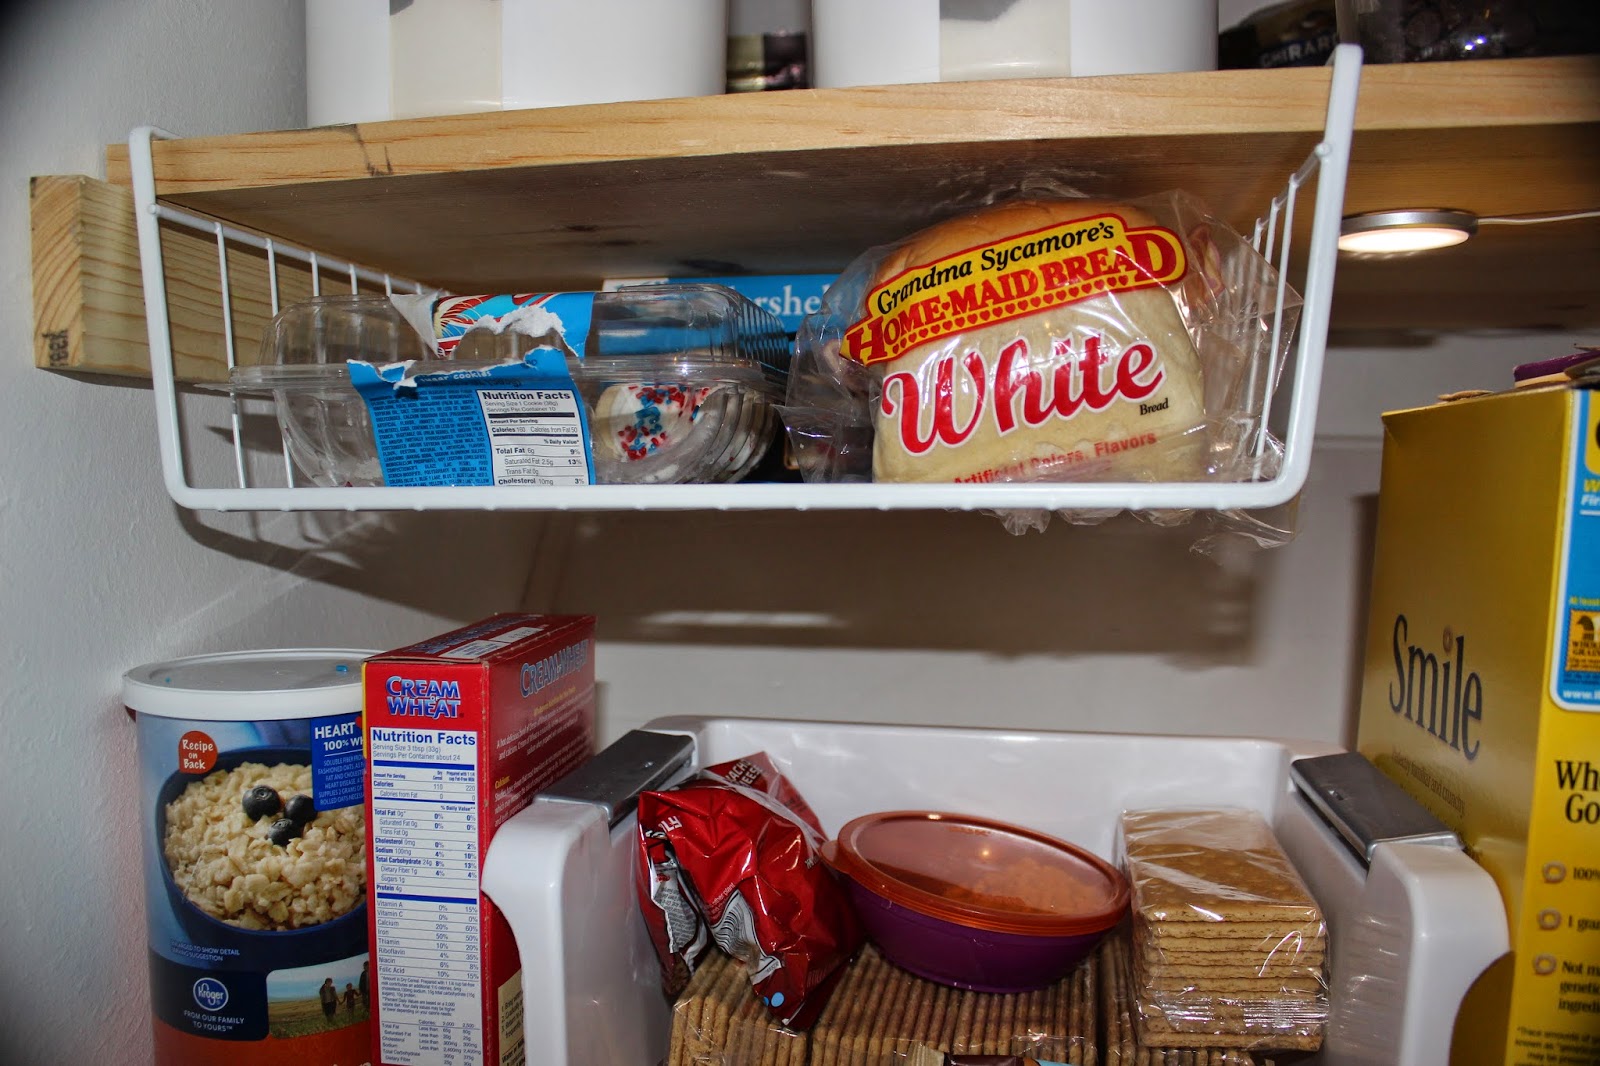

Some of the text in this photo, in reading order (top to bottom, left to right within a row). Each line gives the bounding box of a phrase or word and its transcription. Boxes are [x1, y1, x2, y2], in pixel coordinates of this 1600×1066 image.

[877, 221, 1115, 315] Grandma Sycamore's
[1039, 232, 1178, 292] BREAD
[453, 370, 492, 380] cookies
[482, 391, 571, 400] Nutrition Facts
[880, 334, 1165, 455] White
[1139, 398, 1170, 417] Bread
[1094, 432, 1158, 456] Flavors
[519, 652, 557, 699] CREAM
[386, 676, 461, 699] CREAM
[1389, 614, 1481, 761] Smile
[386, 696, 461, 719] WHEAT
[314, 722, 356, 739] HEART
[372, 730, 476, 746] Nutrition Facts
[182, 739, 214, 753] Recipe
[323, 739, 349, 751] 100%
[373, 744, 394, 752] Serving
[412, 745, 424, 753] tbsp
[373, 751, 397, 759] Servings
[408, 752, 435, 760] Container
[183, 759, 206, 770] Back
[375, 837, 403, 845] Cholesterol
[395, 847, 412, 856] 100mg
[388, 857, 421, 866] Carbohydrate
[380, 865, 398, 873] Dietary
[381, 874, 405, 884] Sugars 1g
[377, 900, 398, 908] Vitamin
[202, 946, 241, 956] SHOW DETAIL
[379, 947, 405, 955] Riboflavin
[197, 983, 224, 1006] Kroger
[184, 1009, 245, 1025] FROM OUR FAMILY
[193, 1020, 203, 1028] TO
